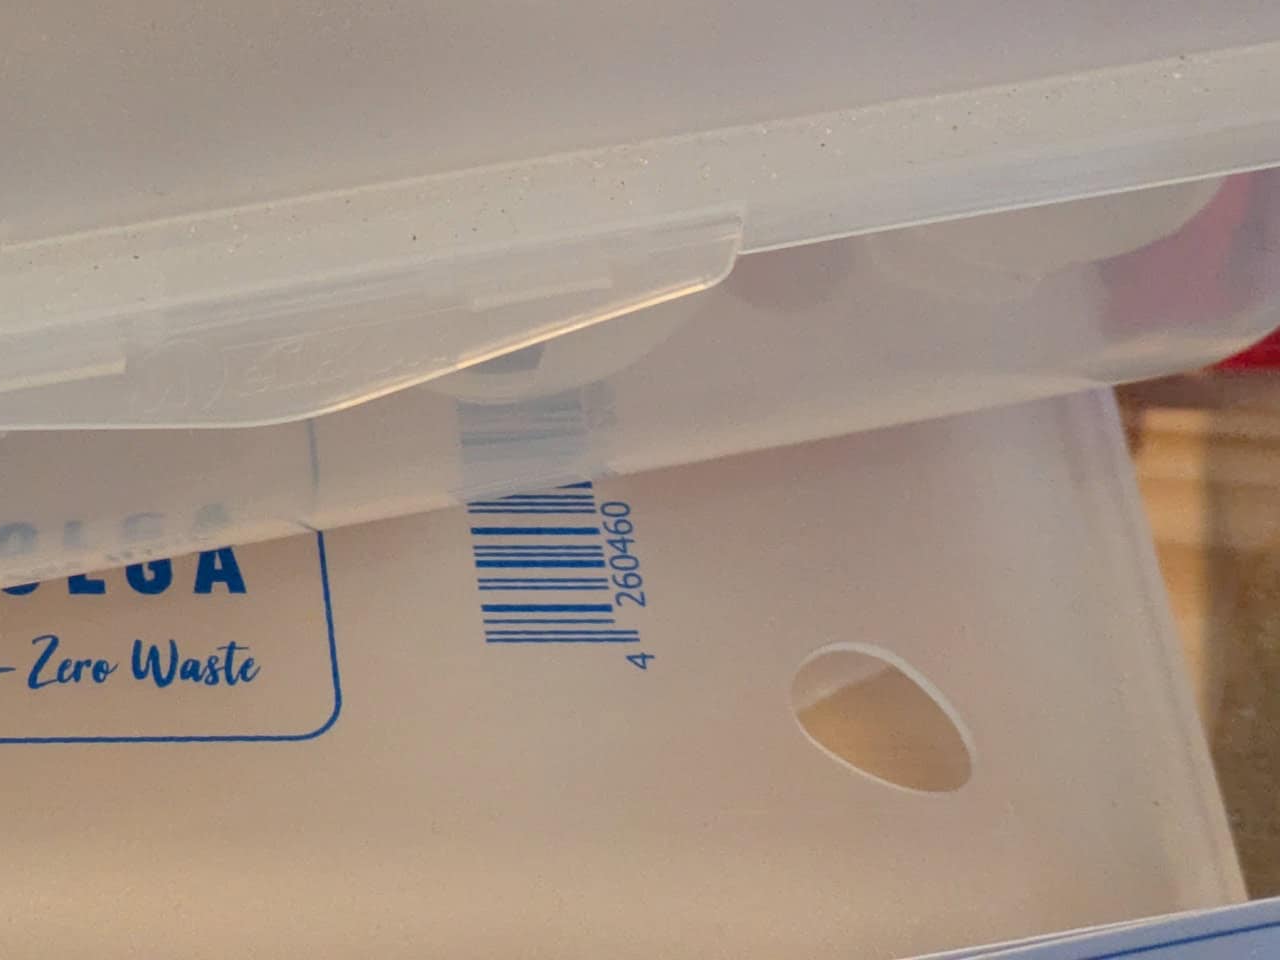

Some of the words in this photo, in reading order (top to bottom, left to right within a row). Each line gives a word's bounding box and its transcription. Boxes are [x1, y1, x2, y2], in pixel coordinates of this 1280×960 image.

[600, 501, 647, 608] 260460
[27, 634, 118, 690] Zero
[131, 638, 262, 688] Waste
[625, 652, 655, 670] 4
